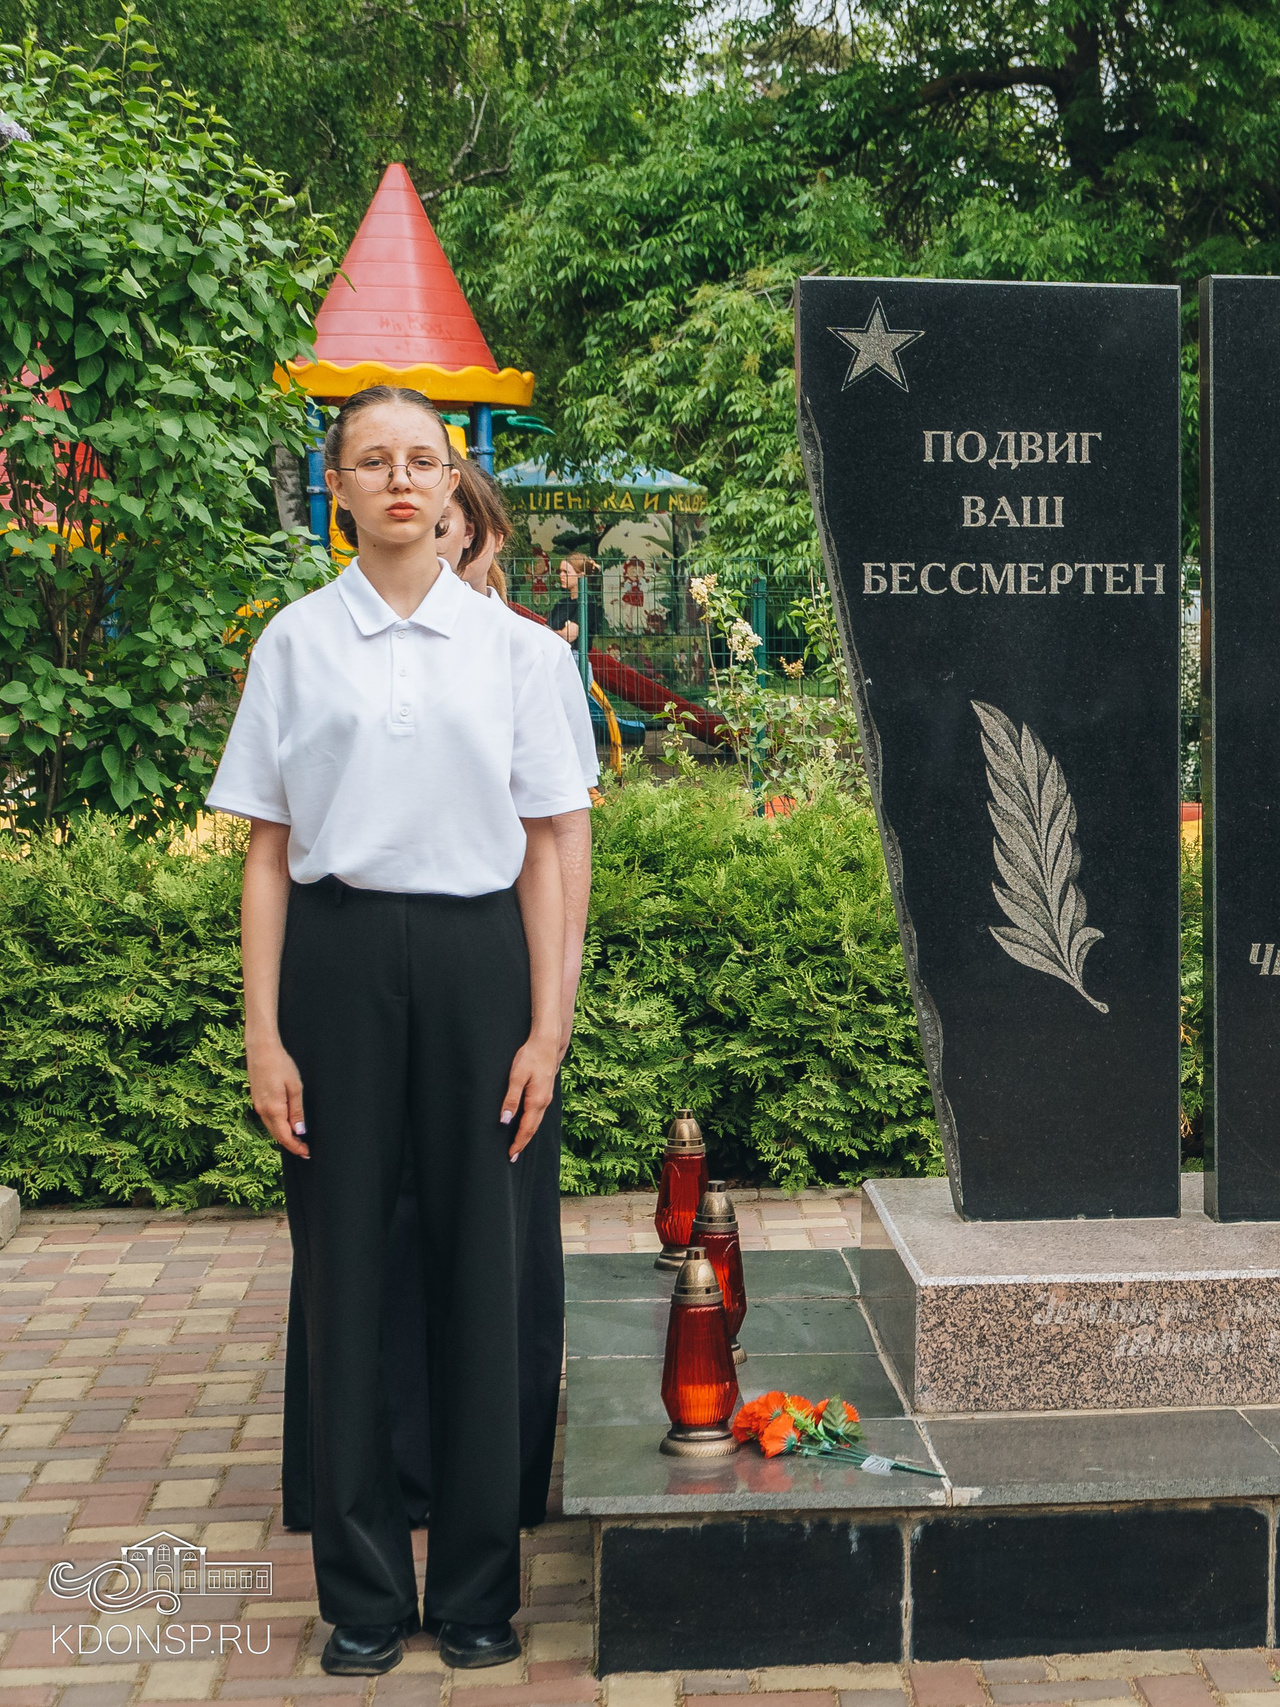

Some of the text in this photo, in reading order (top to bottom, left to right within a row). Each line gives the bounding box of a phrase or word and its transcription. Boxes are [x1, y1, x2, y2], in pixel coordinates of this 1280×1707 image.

[923, 431, 1101, 469] ПОДВИГ
[644, 492, 660, 512] И
[962, 496, 1064, 527] ВАШ
[863, 563, 1165, 594] БЕССМЕРТЕН
